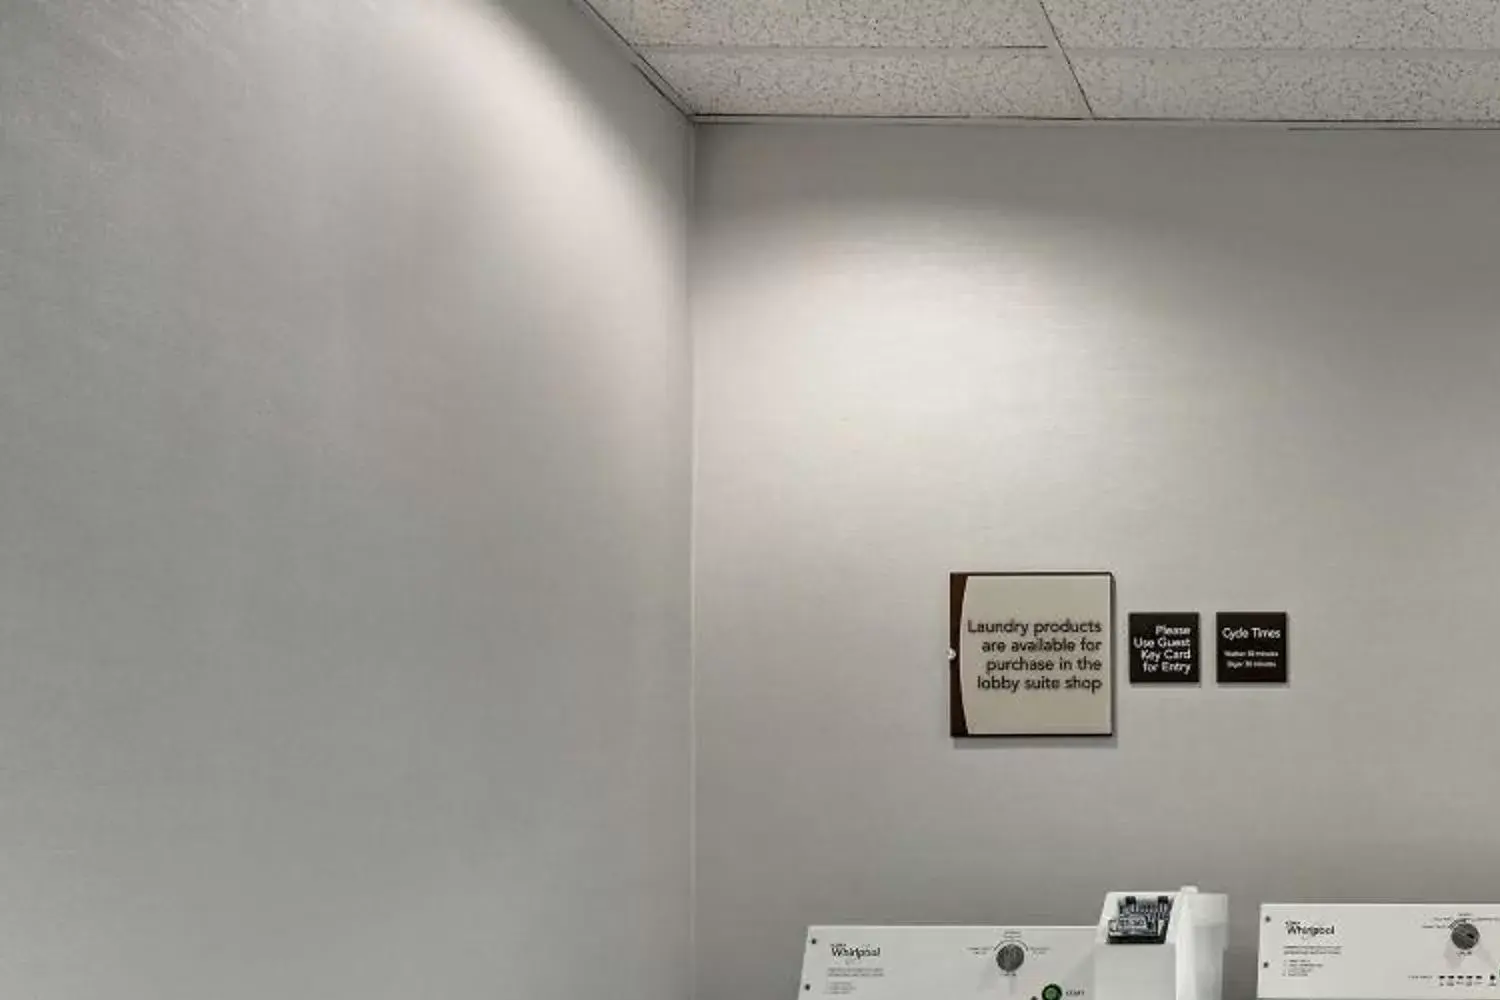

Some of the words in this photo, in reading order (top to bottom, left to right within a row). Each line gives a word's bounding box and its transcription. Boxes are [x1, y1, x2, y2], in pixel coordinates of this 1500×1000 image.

[967, 618, 1029, 637] Laundry
[1033, 618, 1103, 637] products
[1155, 625, 1191, 636] Please
[1221, 626, 1249, 641] Cycle
[1250, 627, 1281, 639] Times
[981, 641, 1006, 653] are
[1011, 637, 1077, 653] available
[1080, 636, 1102, 652] for
[1133, 636, 1155, 649] Use
[1157, 636, 1191, 649] Guest
[1141, 649, 1160, 663] Key
[1163, 648, 1191, 660] Card
[986, 656, 1055, 675] purchase
[1059, 656, 1073, 671] in
[1077, 655, 1102, 671] the
[1143, 660, 1159, 672] for
[1161, 661, 1191, 676] Entry
[976, 675, 1020, 694] lobby
[1024, 675, 1061, 691] suite
[1065, 675, 1103, 694] shop
[1286, 925, 1335, 937] Whirlpool
[831, 947, 881, 960] Whirlpool
